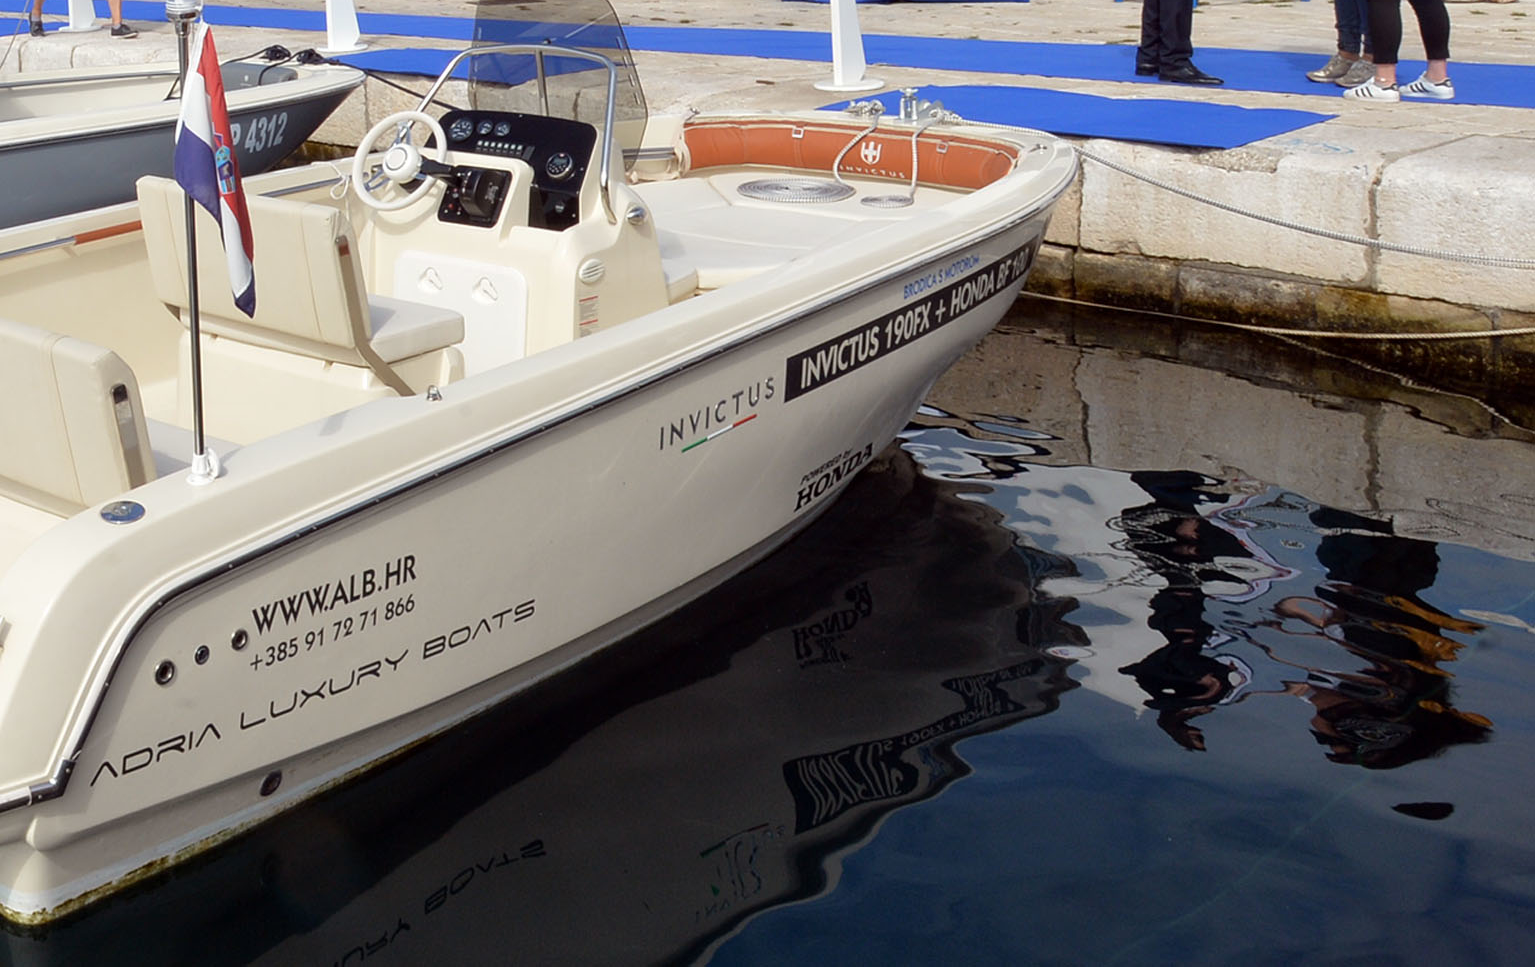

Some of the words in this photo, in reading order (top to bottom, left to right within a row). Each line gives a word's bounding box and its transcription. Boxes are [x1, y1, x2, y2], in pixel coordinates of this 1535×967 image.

[244, 112, 288, 154] 4312
[839, 164, 905, 179] INVICTUS
[904, 273, 938, 300] BRODICA
[800, 326, 880, 390] INVICTUS
[885, 302, 932, 349] 190FX
[935, 299, 946, 323] +
[950, 270, 995, 317] HONDA
[996, 259, 1012, 290] BF
[659, 377, 775, 451] INVICTUS
[793, 442, 873, 513] HONDA
[800, 452, 844, 484] POWERED
[252, 554, 417, 636] WWW.ALB.HR
[250, 636, 299, 671] +385
[304, 627, 325, 652] 91
[333, 617, 354, 641] 72
[359, 607, 378, 631] 71
[384, 593, 416, 621] 866
[90, 723, 221, 787] ADRIA
[239, 649, 409, 731] LUXURY
[422, 599, 536, 661] BOATS
